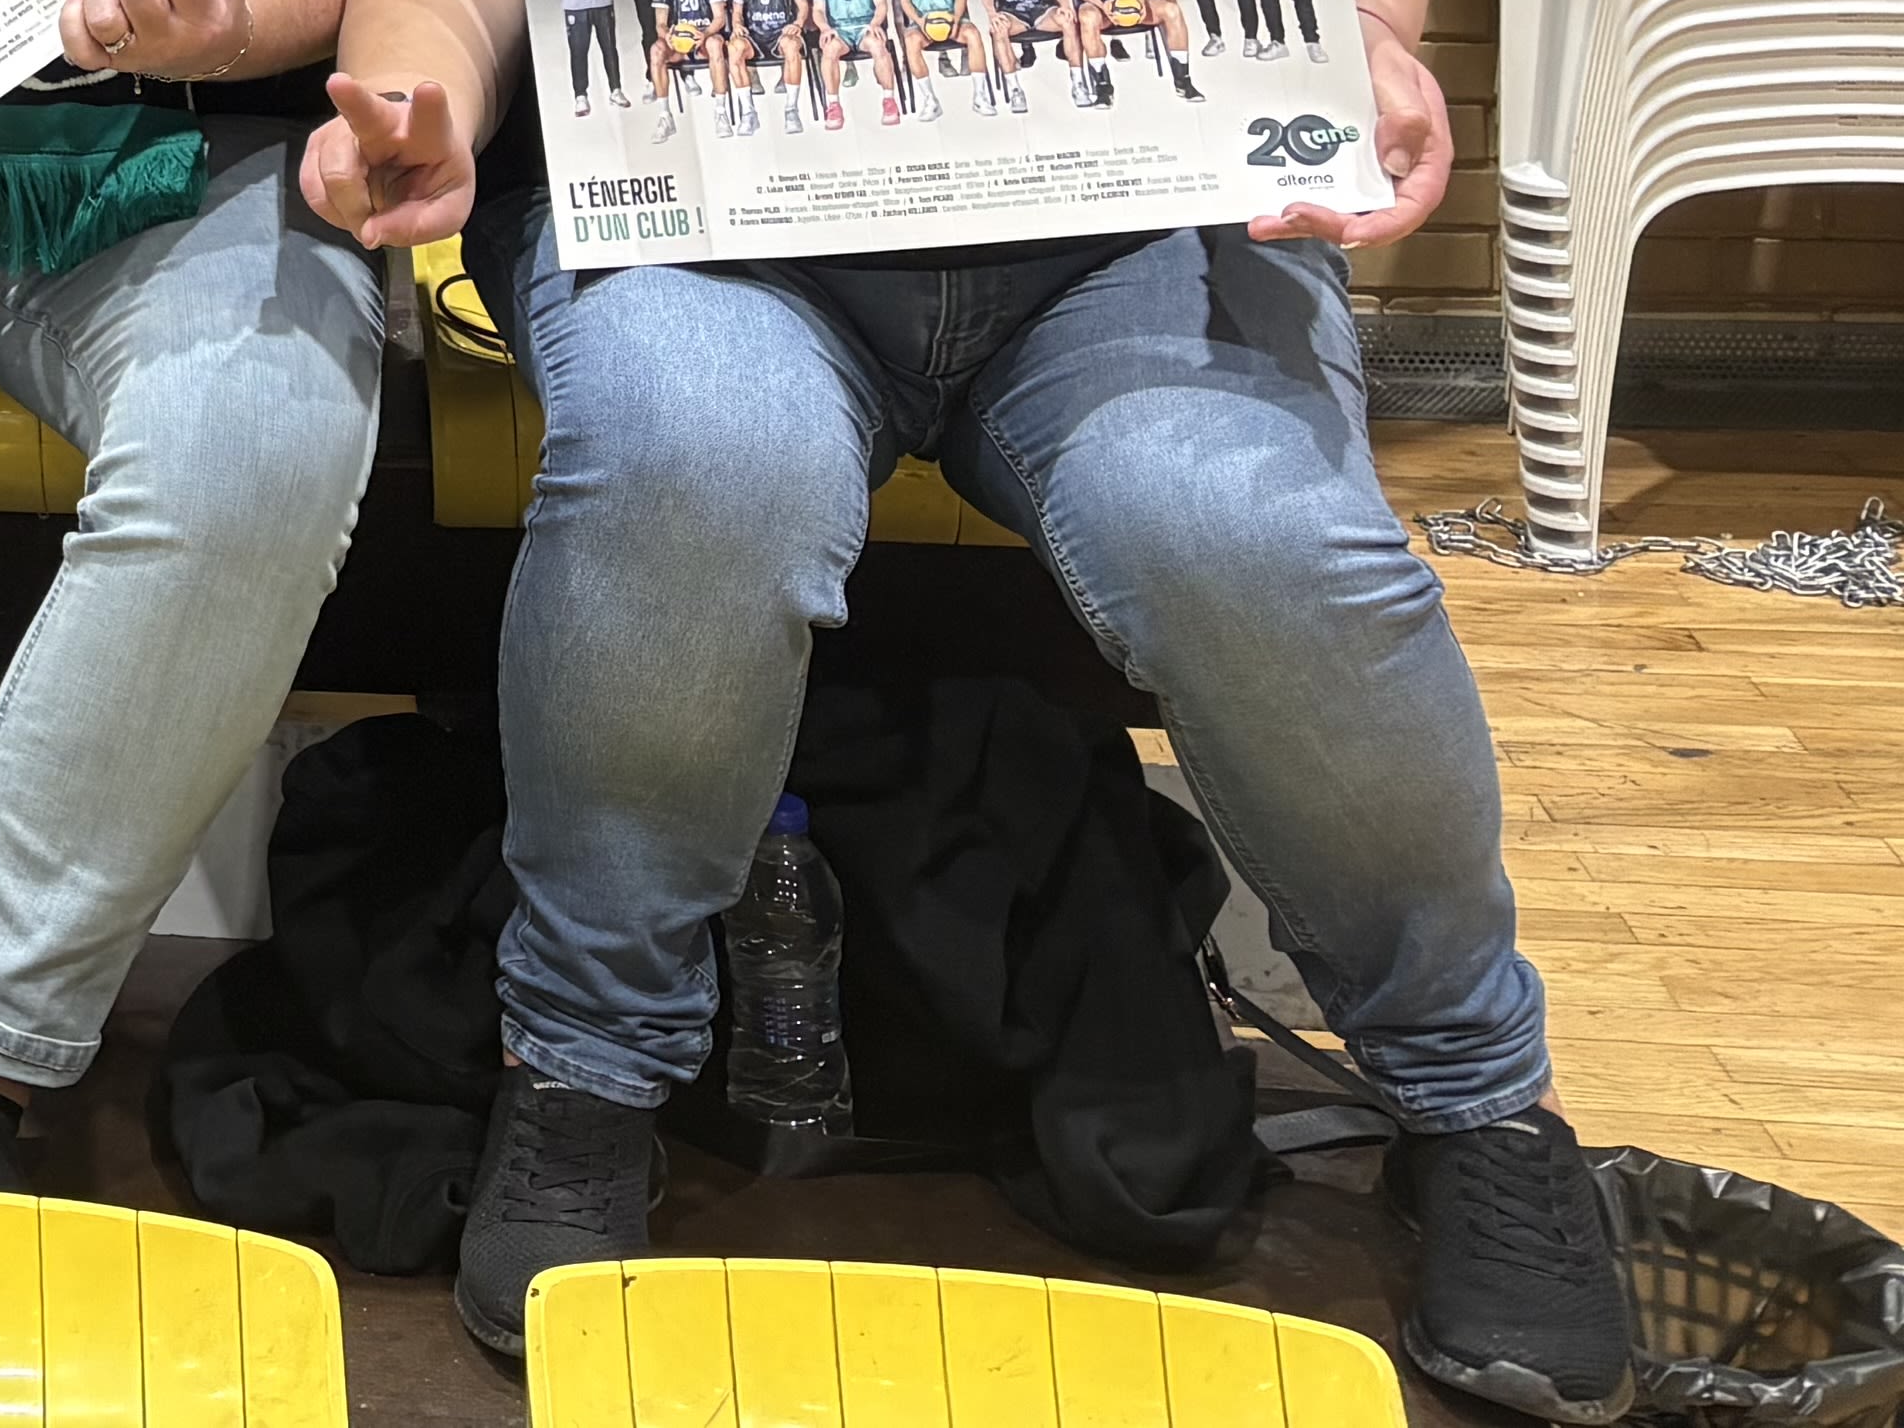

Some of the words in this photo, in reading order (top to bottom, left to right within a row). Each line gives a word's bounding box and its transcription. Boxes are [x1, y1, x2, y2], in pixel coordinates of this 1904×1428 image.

[1247, 114, 1341, 167] 20
[1311, 126, 1360, 145] ans
[569, 175, 677, 209] L'ÉNERGIE
[573, 213, 630, 243] D'UN
[636, 208, 690, 239] CLUB
[696, 206, 704, 234] !
